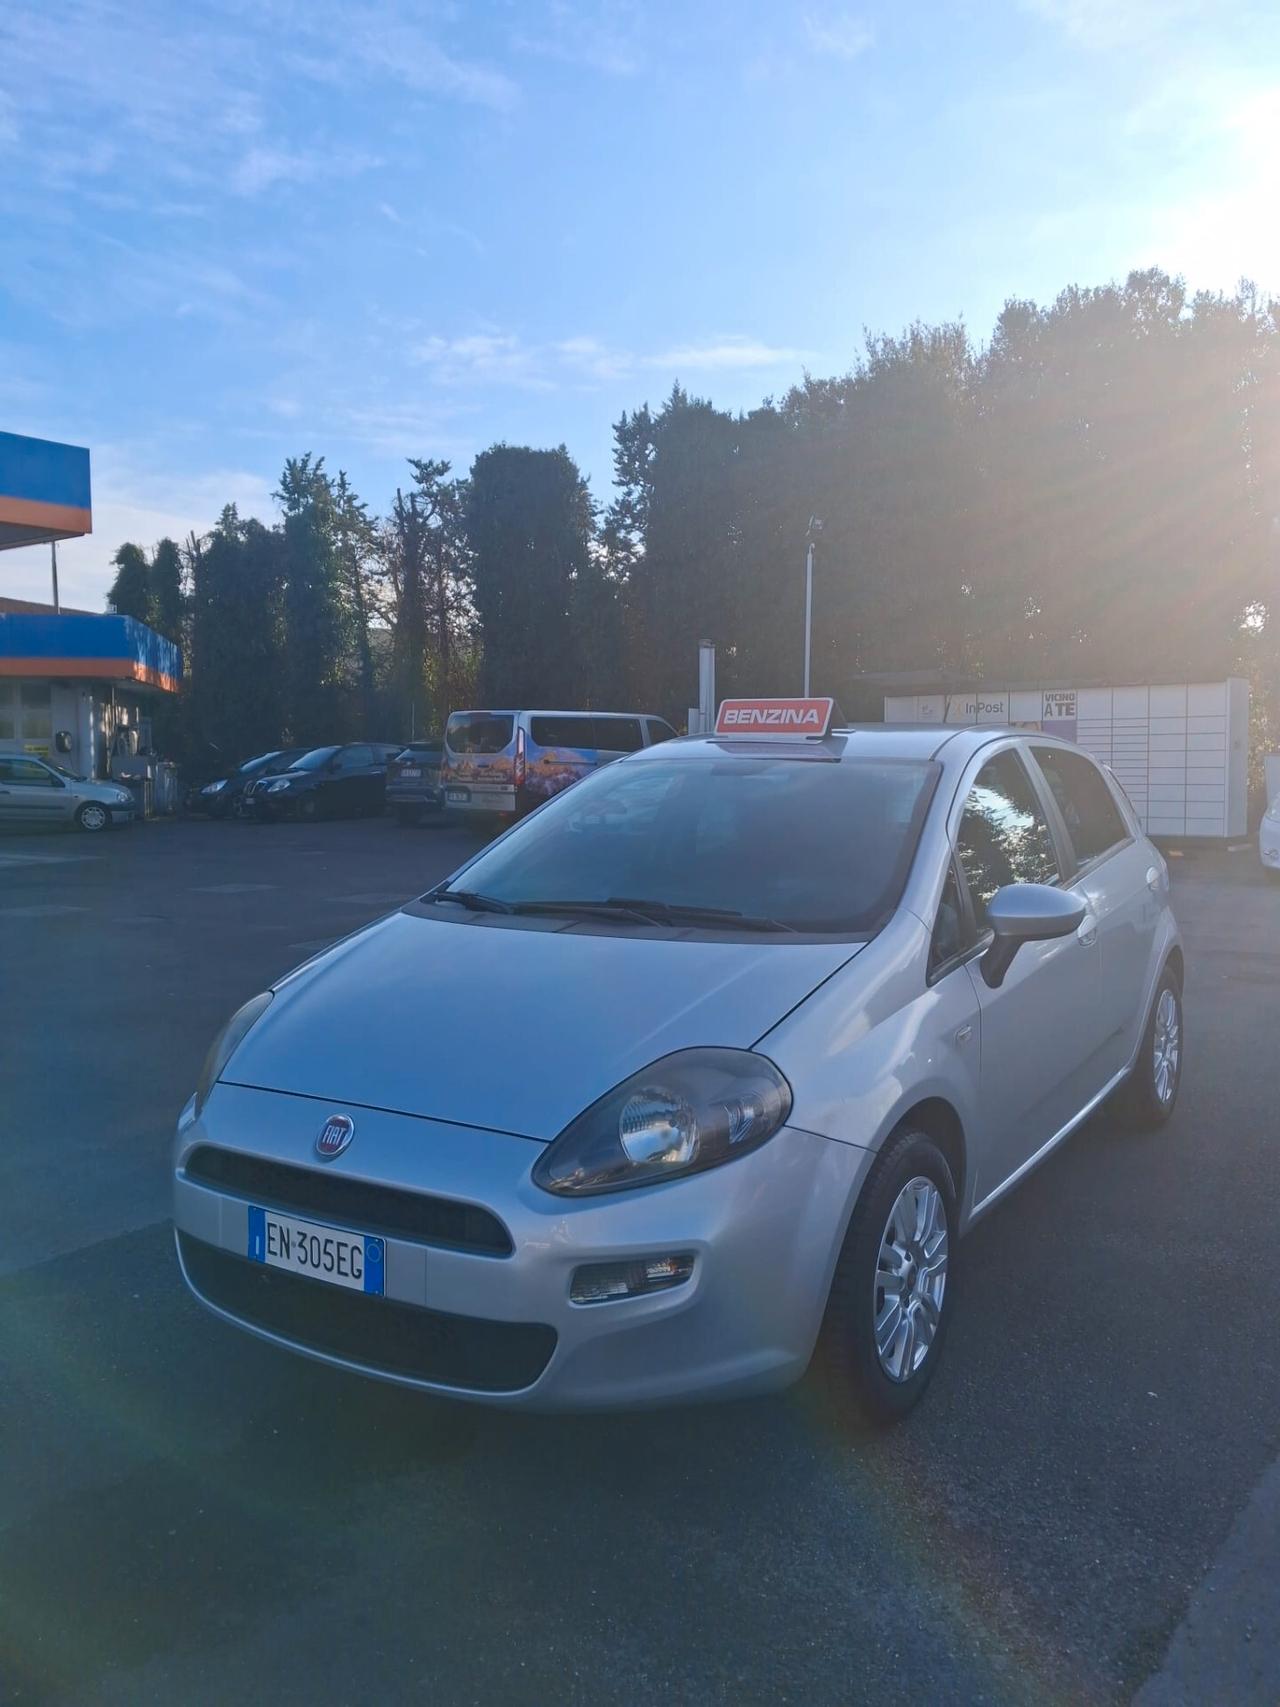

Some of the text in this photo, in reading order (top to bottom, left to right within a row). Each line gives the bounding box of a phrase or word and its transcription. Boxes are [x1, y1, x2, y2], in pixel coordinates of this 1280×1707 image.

[1044, 693, 1075, 702] VICINO
[965, 702, 1004, 715] InPost
[1044, 703, 1076, 717] A TE
[723, 709, 819, 725] BENZINA
[322, 1124, 348, 1146] FIAT
[267, 1222, 363, 1280] EN 305EG
